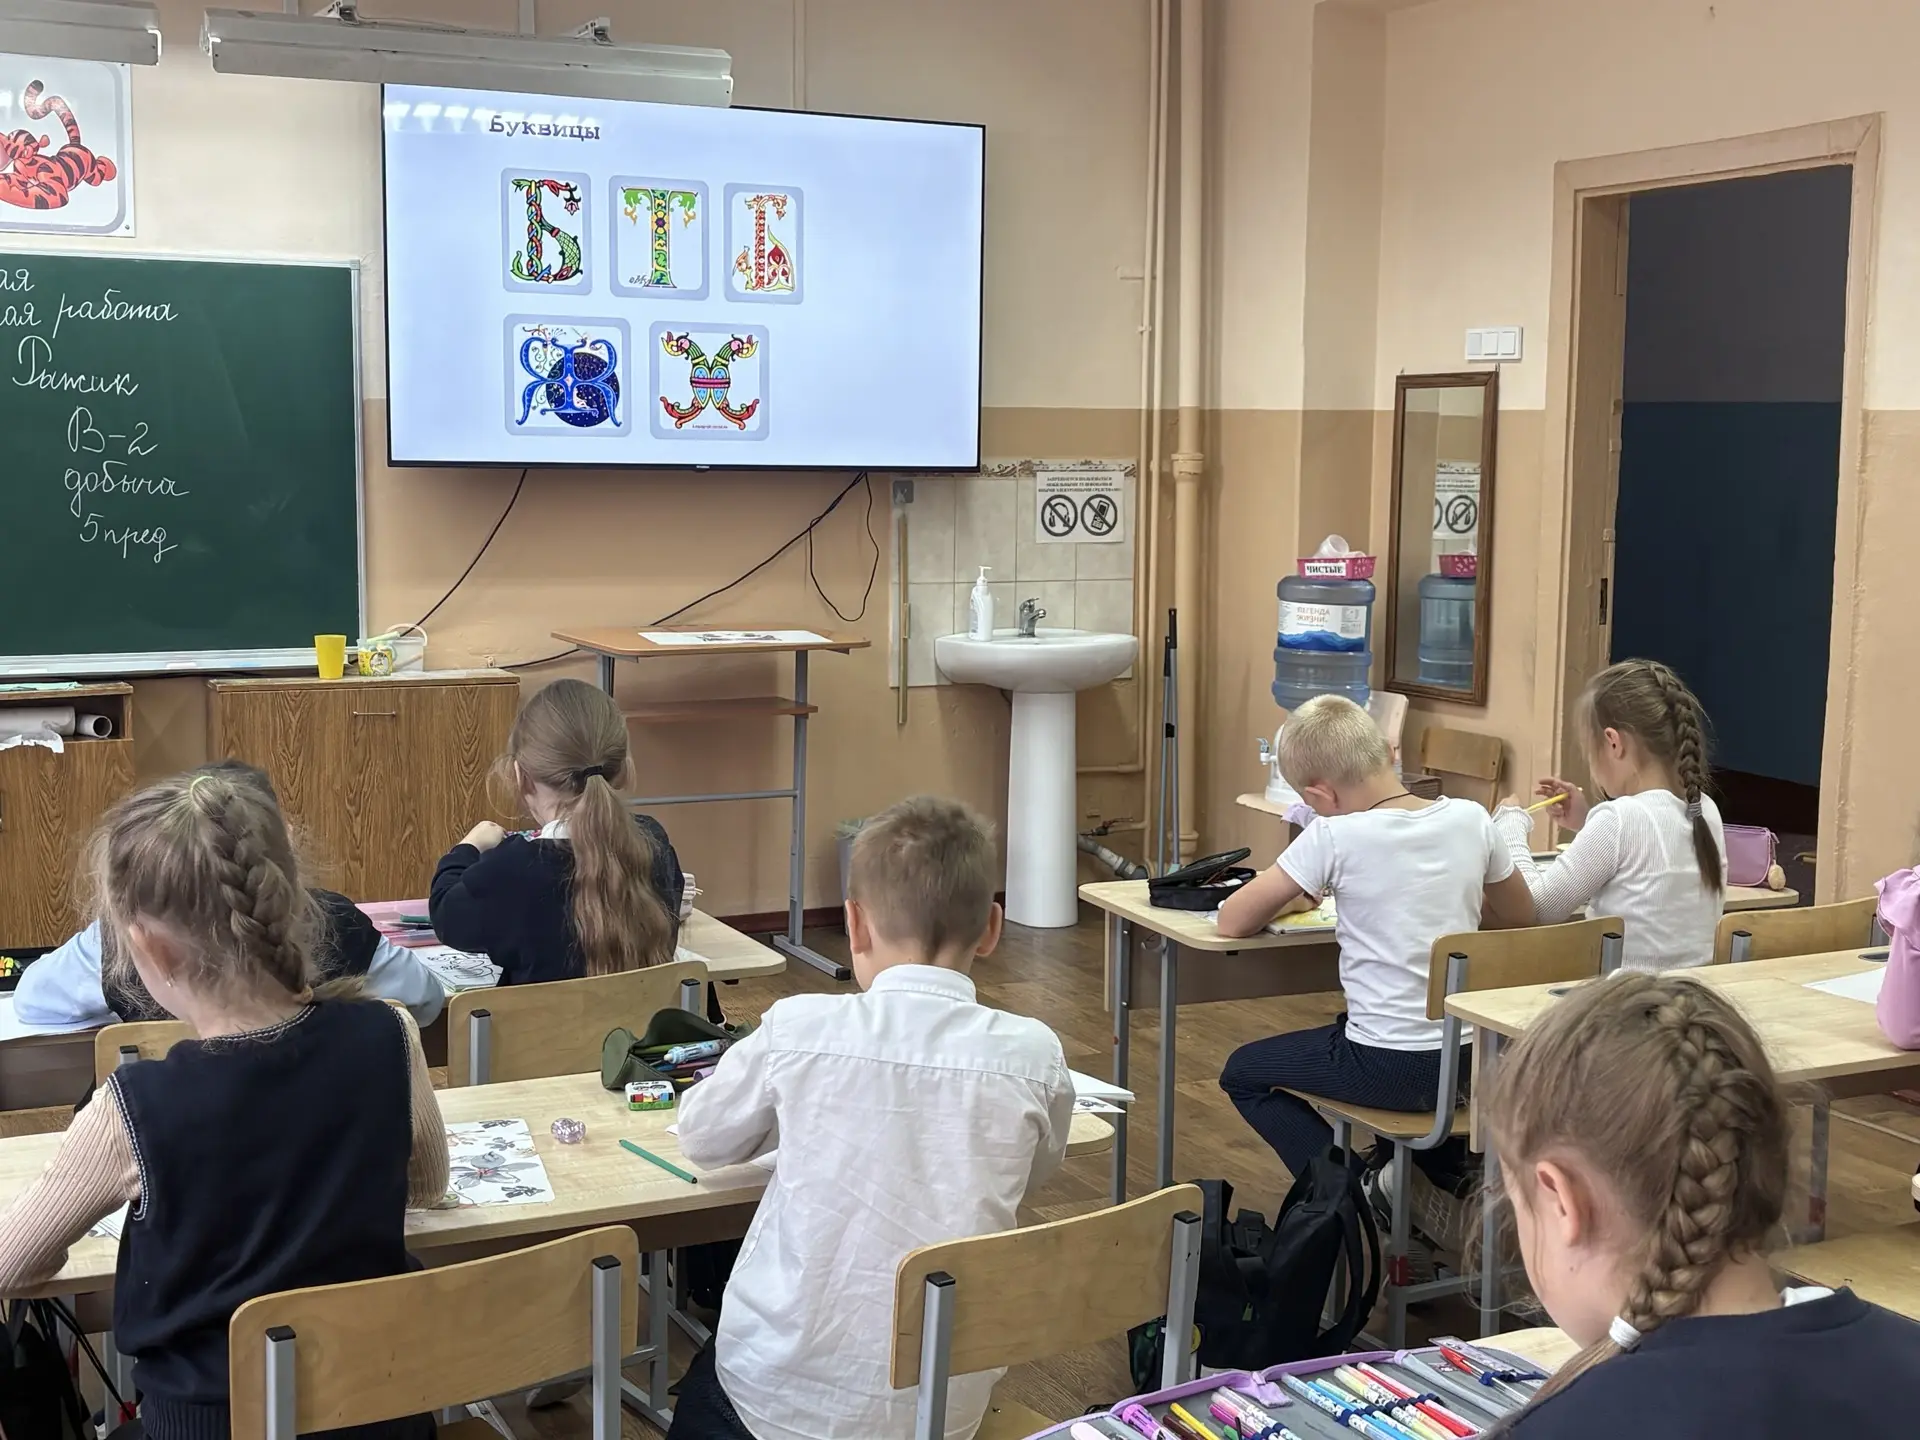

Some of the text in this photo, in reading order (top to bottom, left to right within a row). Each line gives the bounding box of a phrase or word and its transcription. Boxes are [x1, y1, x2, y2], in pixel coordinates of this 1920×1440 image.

[489, 114, 600, 142] Буквицы
[52, 288, 179, 338] работа
[67, 405, 159, 456] В-2
[64, 460, 190, 517] добыча
[1306, 565, 1344, 574] ЧИСТЫЕ
[1297, 606, 1331, 616] ЛЕГЕНДА
